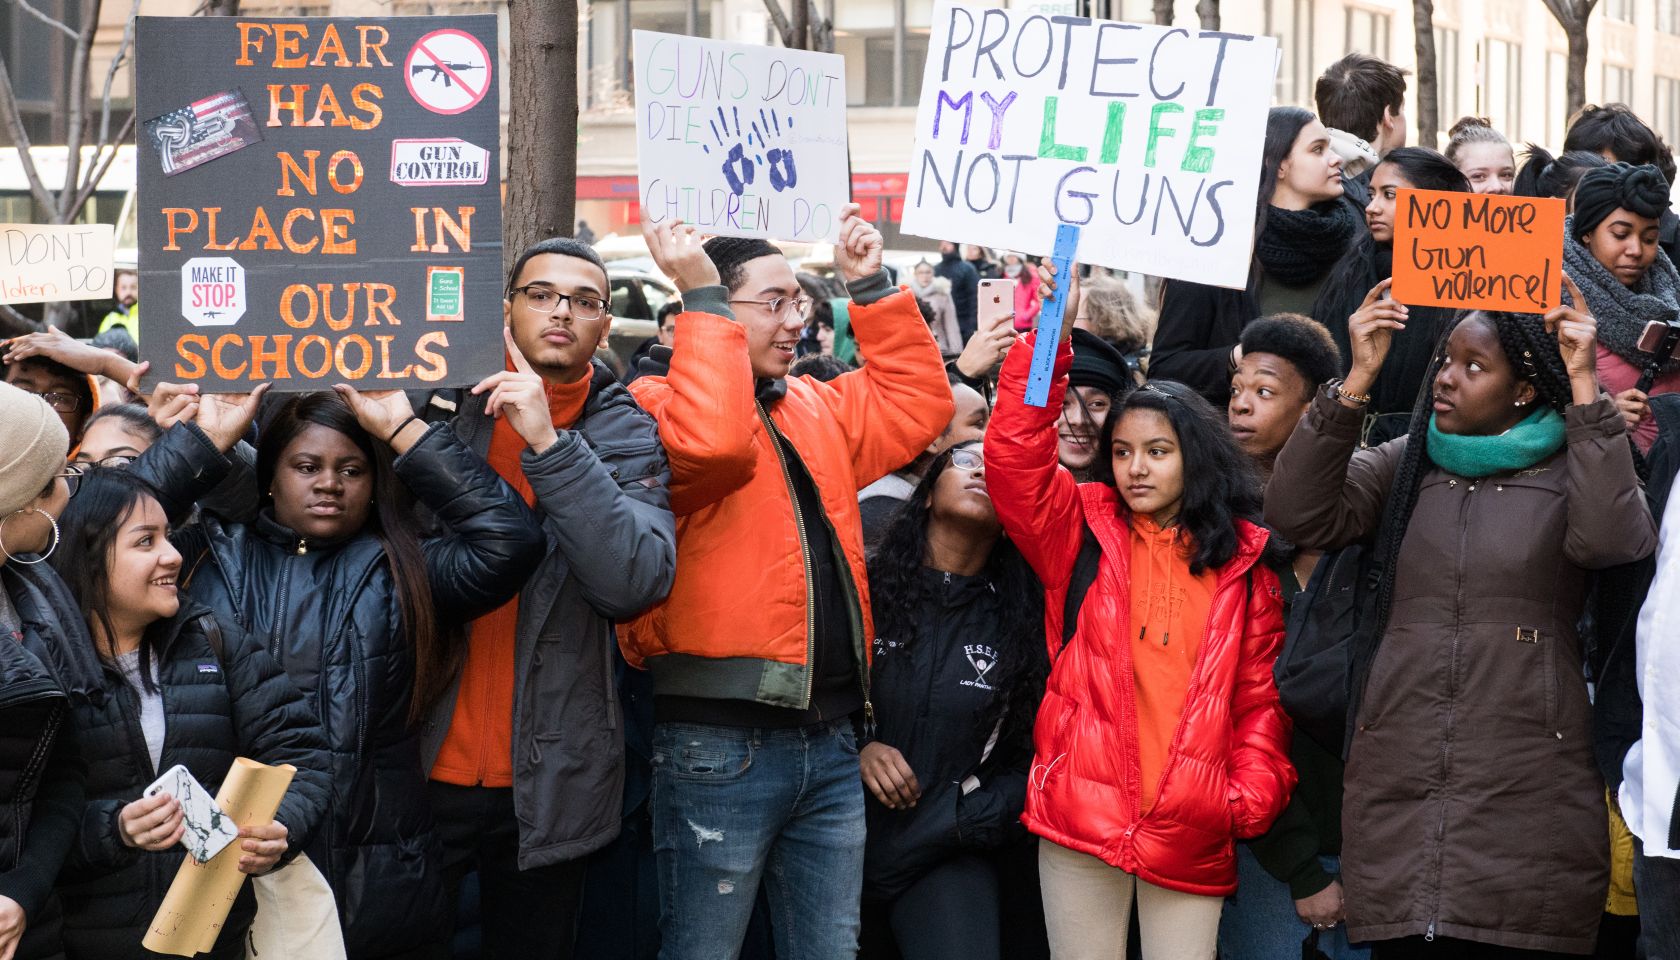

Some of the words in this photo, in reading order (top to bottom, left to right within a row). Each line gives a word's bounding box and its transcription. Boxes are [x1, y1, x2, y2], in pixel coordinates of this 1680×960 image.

[235, 22, 392, 68] FEAR
[942, 7, 1254, 107] PROTECT
[646, 38, 749, 100] GUNS
[266, 82, 384, 130] HAS
[647, 101, 701, 144] DIE
[419, 146, 462, 160] GUN
[933, 90, 1017, 149] MY
[1038, 96, 1225, 173] LIFE
[276, 150, 364, 197] NO
[396, 161, 482, 179] CONTROL
[645, 178, 770, 231] CHILDREN
[793, 198, 832, 237] DO
[917, 149, 1037, 223] NOT
[1054, 166, 1234, 247] GUNS
[1463, 197, 1536, 234] More
[5, 229, 94, 266] DONT
[161, 206, 357, 255] PLACE
[411, 206, 476, 253] IN
[68, 265, 106, 291] DO
[192, 266, 223, 282] MAKE
[227, 266, 237, 282] IT
[192, 284, 236, 307] STOP.
[1432, 258, 1550, 309] violence!
[279, 282, 401, 331] OUR
[175, 331, 449, 381] SCHOOLS
